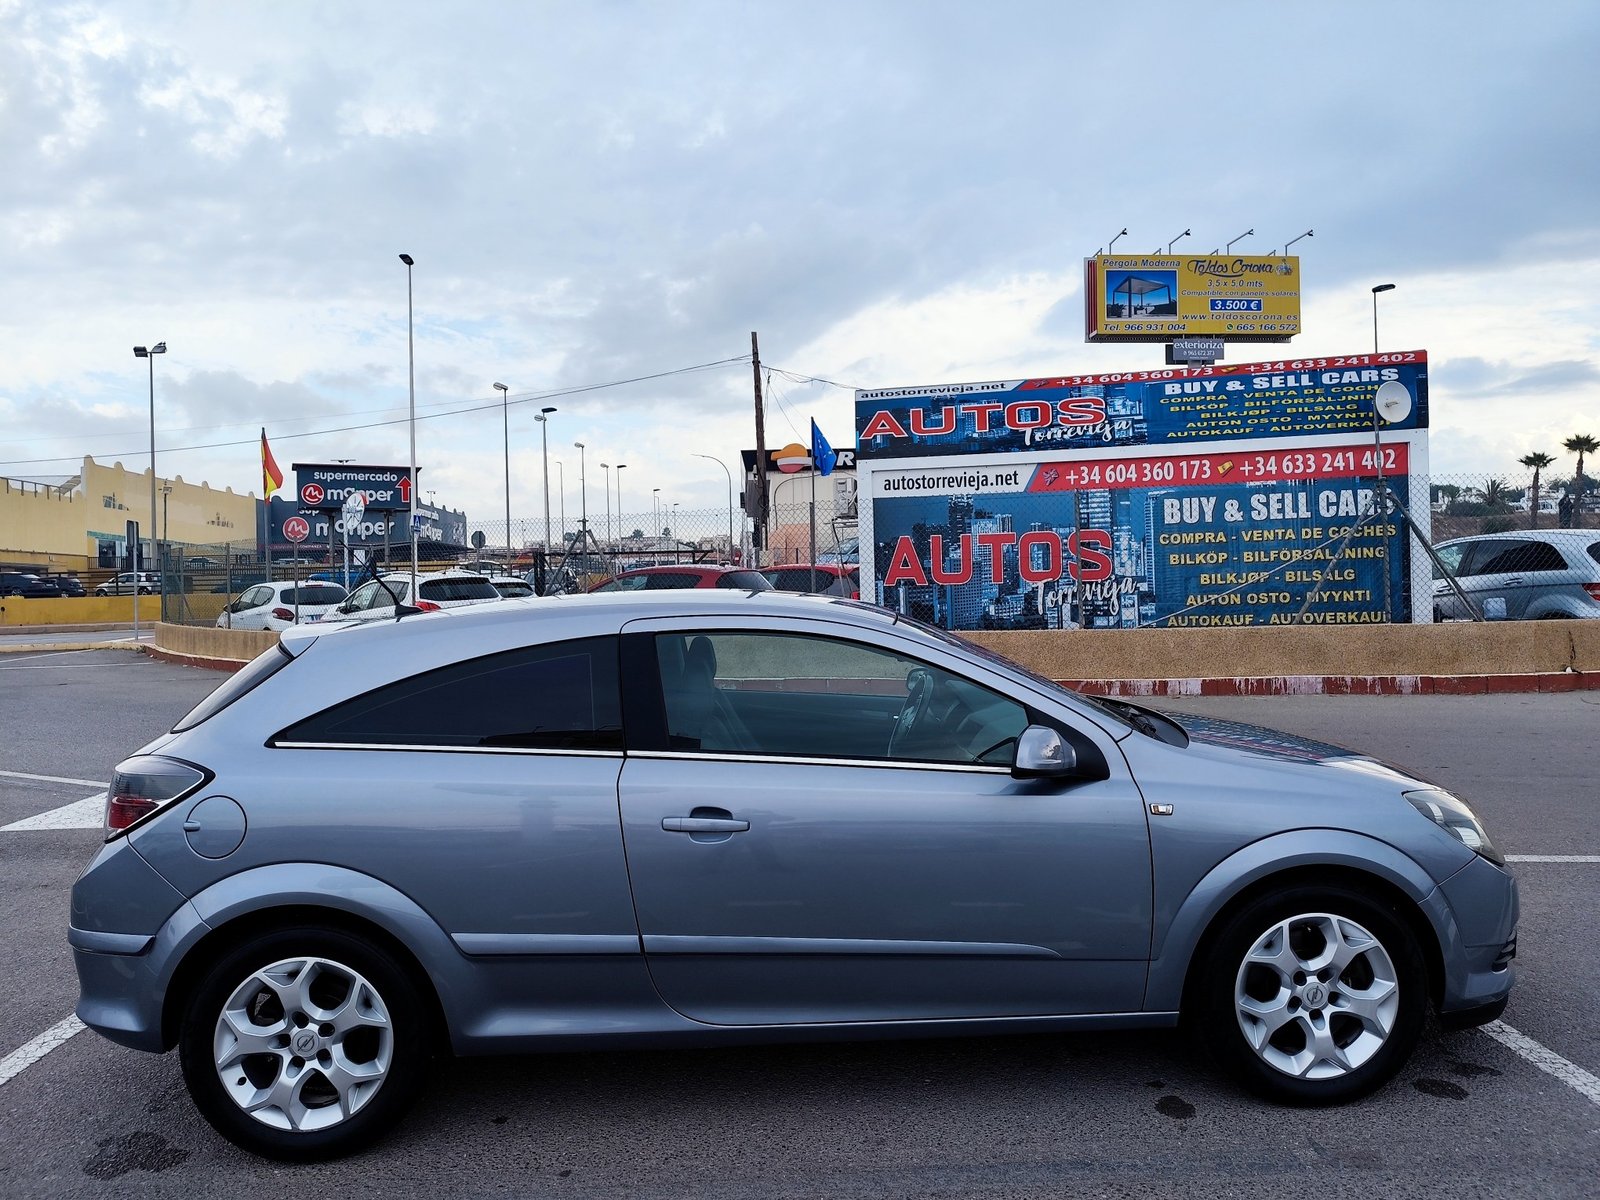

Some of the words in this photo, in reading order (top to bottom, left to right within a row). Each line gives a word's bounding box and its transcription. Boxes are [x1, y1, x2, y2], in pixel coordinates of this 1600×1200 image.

[1140, 259, 1181, 267] Moderna
[1187, 259, 1228, 276] Toldos
[1231, 259, 1273, 274] Corona
[1246, 280, 1263, 288] mts
[1181, 289, 1223, 297] Compatible
[1214, 301, 1248, 310] 3.500
[1250, 301, 1259, 310] €
[1181, 313, 1298, 321] www.toldoscorona.es
[1167, 323, 1186, 331] 004
[1173, 340, 1224, 349] exterioriza
[1245, 361, 1286, 372] +34
[1291, 358, 1327, 369] 633
[1334, 355, 1370, 366] 241
[1377, 352, 1416, 362] 402
[1056, 375, 1095, 386] +34
[1099, 373, 1134, 383] 604
[1138, 370, 1174, 380] 360
[1179, 367, 1214, 377] 173
[1164, 380, 1218, 395] BUY
[1225, 380, 1245, 391] &
[1252, 373, 1314, 389] SELL
[1321, 368, 1399, 385] CARS
[860, 382, 1006, 399] autostorrevieja.net
[1159, 395, 1227, 404] COMPRA
[1243, 390, 1298, 398] VENTA
[1331, 384, 1379, 393] COCH
[1170, 402, 1229, 412] BILKÖP
[1244, 394, 1375, 407] BILFÖRSÄLJNIN
[1200, 409, 1270, 419] BILKJØP
[1286, 403, 1358, 413] BILSALG
[859, 397, 1106, 440] AUTOS
[1186, 420, 1242, 428] AUTON
[1247, 416, 1292, 424] OSTO
[1307, 412, 1374, 421] MYYNTI
[1016, 419, 1132, 446] Torrevieja
[1167, 427, 1254, 438] AUTOKAUF
[1240, 456, 1277, 476] +34
[1282, 453, 1316, 474] 633
[1322, 451, 1354, 472] 241
[1361, 448, 1396, 470] 402
[313, 471, 398, 482] supermercado
[883, 470, 1020, 491] autostorrevieja.net
[1065, 465, 1101, 485] +34
[1105, 464, 1137, 483] 604
[1142, 461, 1174, 482] 360
[1179, 459, 1211, 480] 173
[1163, 496, 1217, 525] BUY
[1224, 499, 1244, 522] &
[1251, 492, 1312, 521] SELL
[1159, 532, 1227, 545] COMPRA
[1242, 527, 1296, 542] VENTA
[1301, 527, 1323, 539] DE
[884, 529, 1113, 587] AUTOS
[1169, 551, 1228, 565] BILKÖP
[1200, 570, 1269, 585] BILKJØP
[1037, 574, 1138, 616] Torrevieja
[1186, 592, 1241, 606] AUTON
[1246, 592, 1291, 605] OSTO
[1167, 614, 1254, 627] AUTOKAUF
